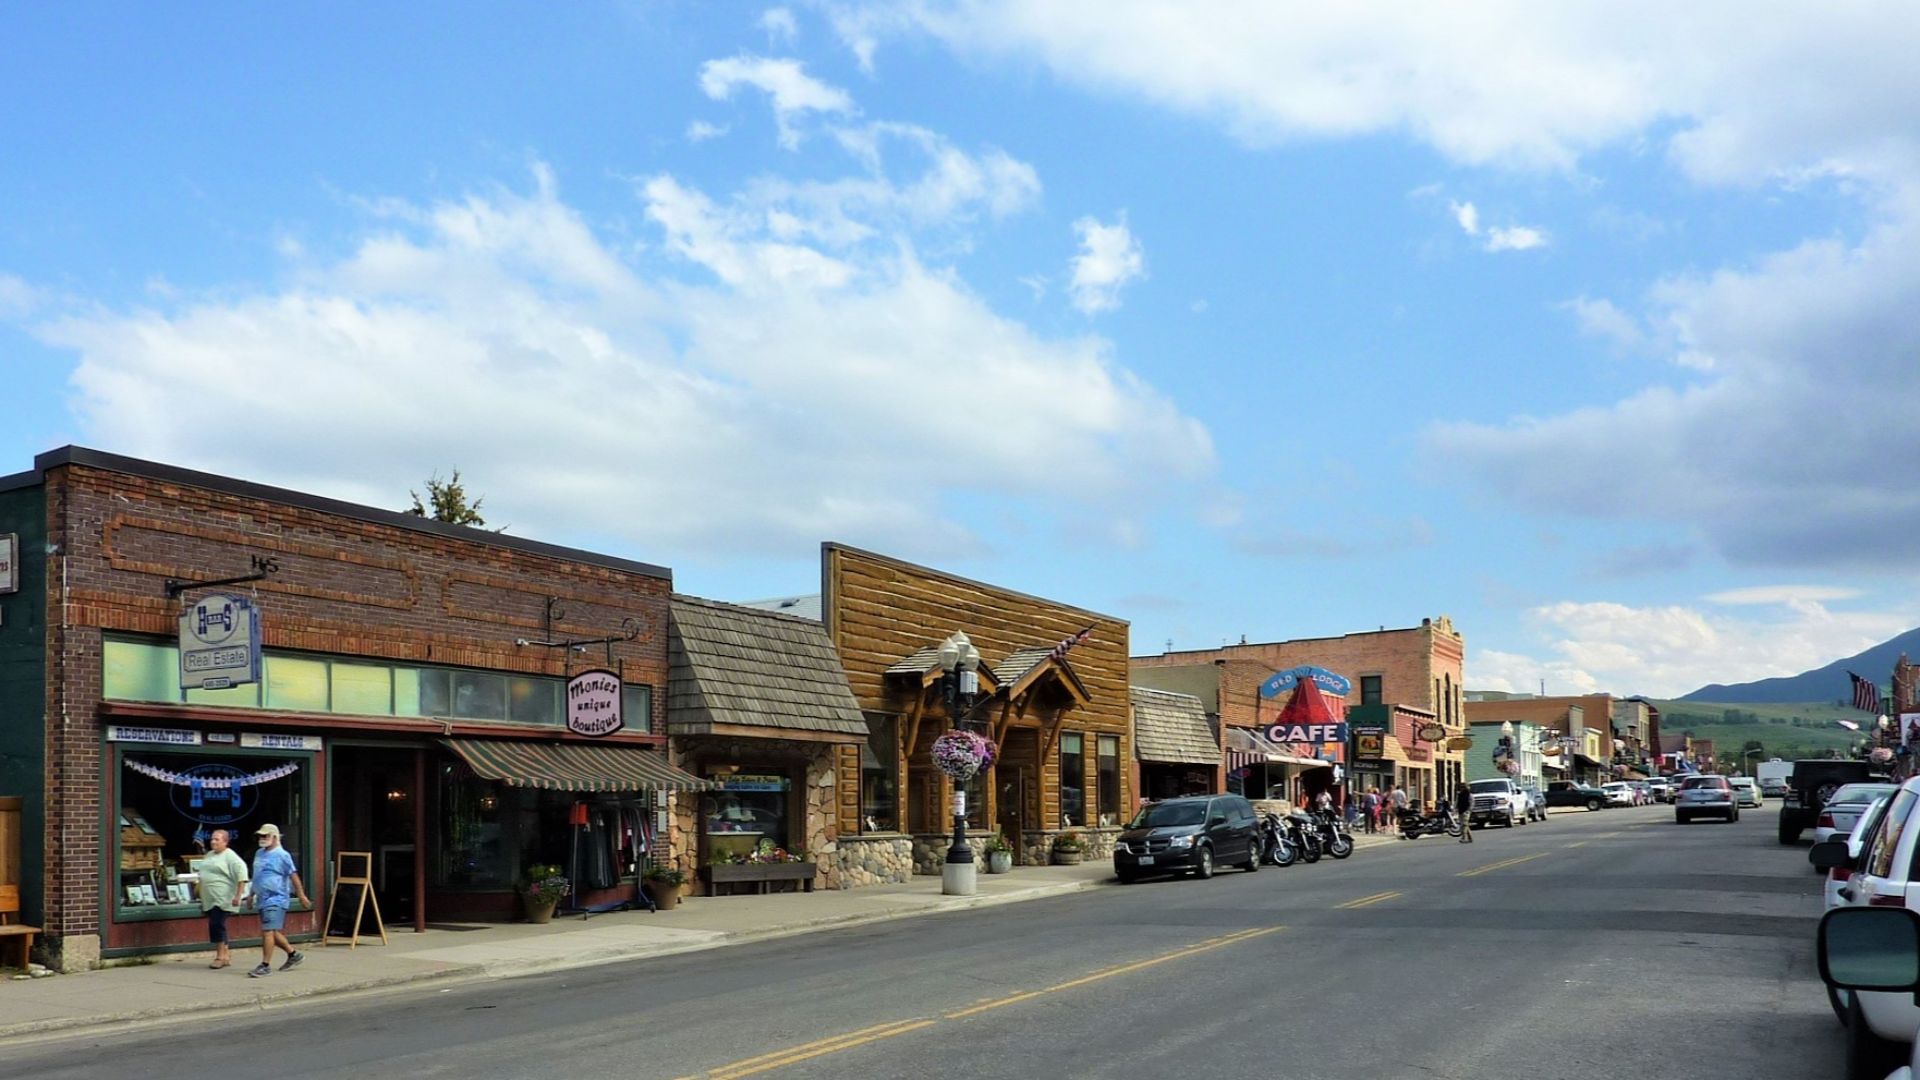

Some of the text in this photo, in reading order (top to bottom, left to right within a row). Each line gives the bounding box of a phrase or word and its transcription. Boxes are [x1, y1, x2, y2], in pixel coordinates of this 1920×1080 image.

[188, 650, 245, 667] Real Estate
[570, 676, 617, 700] Monies
[1271, 675, 1344, 690] RED LODGE
[577, 698, 611, 712] unique
[572, 713, 617, 732] boutique
[115, 727, 195, 743] RESERVATIONS
[261, 735, 304, 748] RENTALS
[1269, 725, 1338, 742] CAFE
